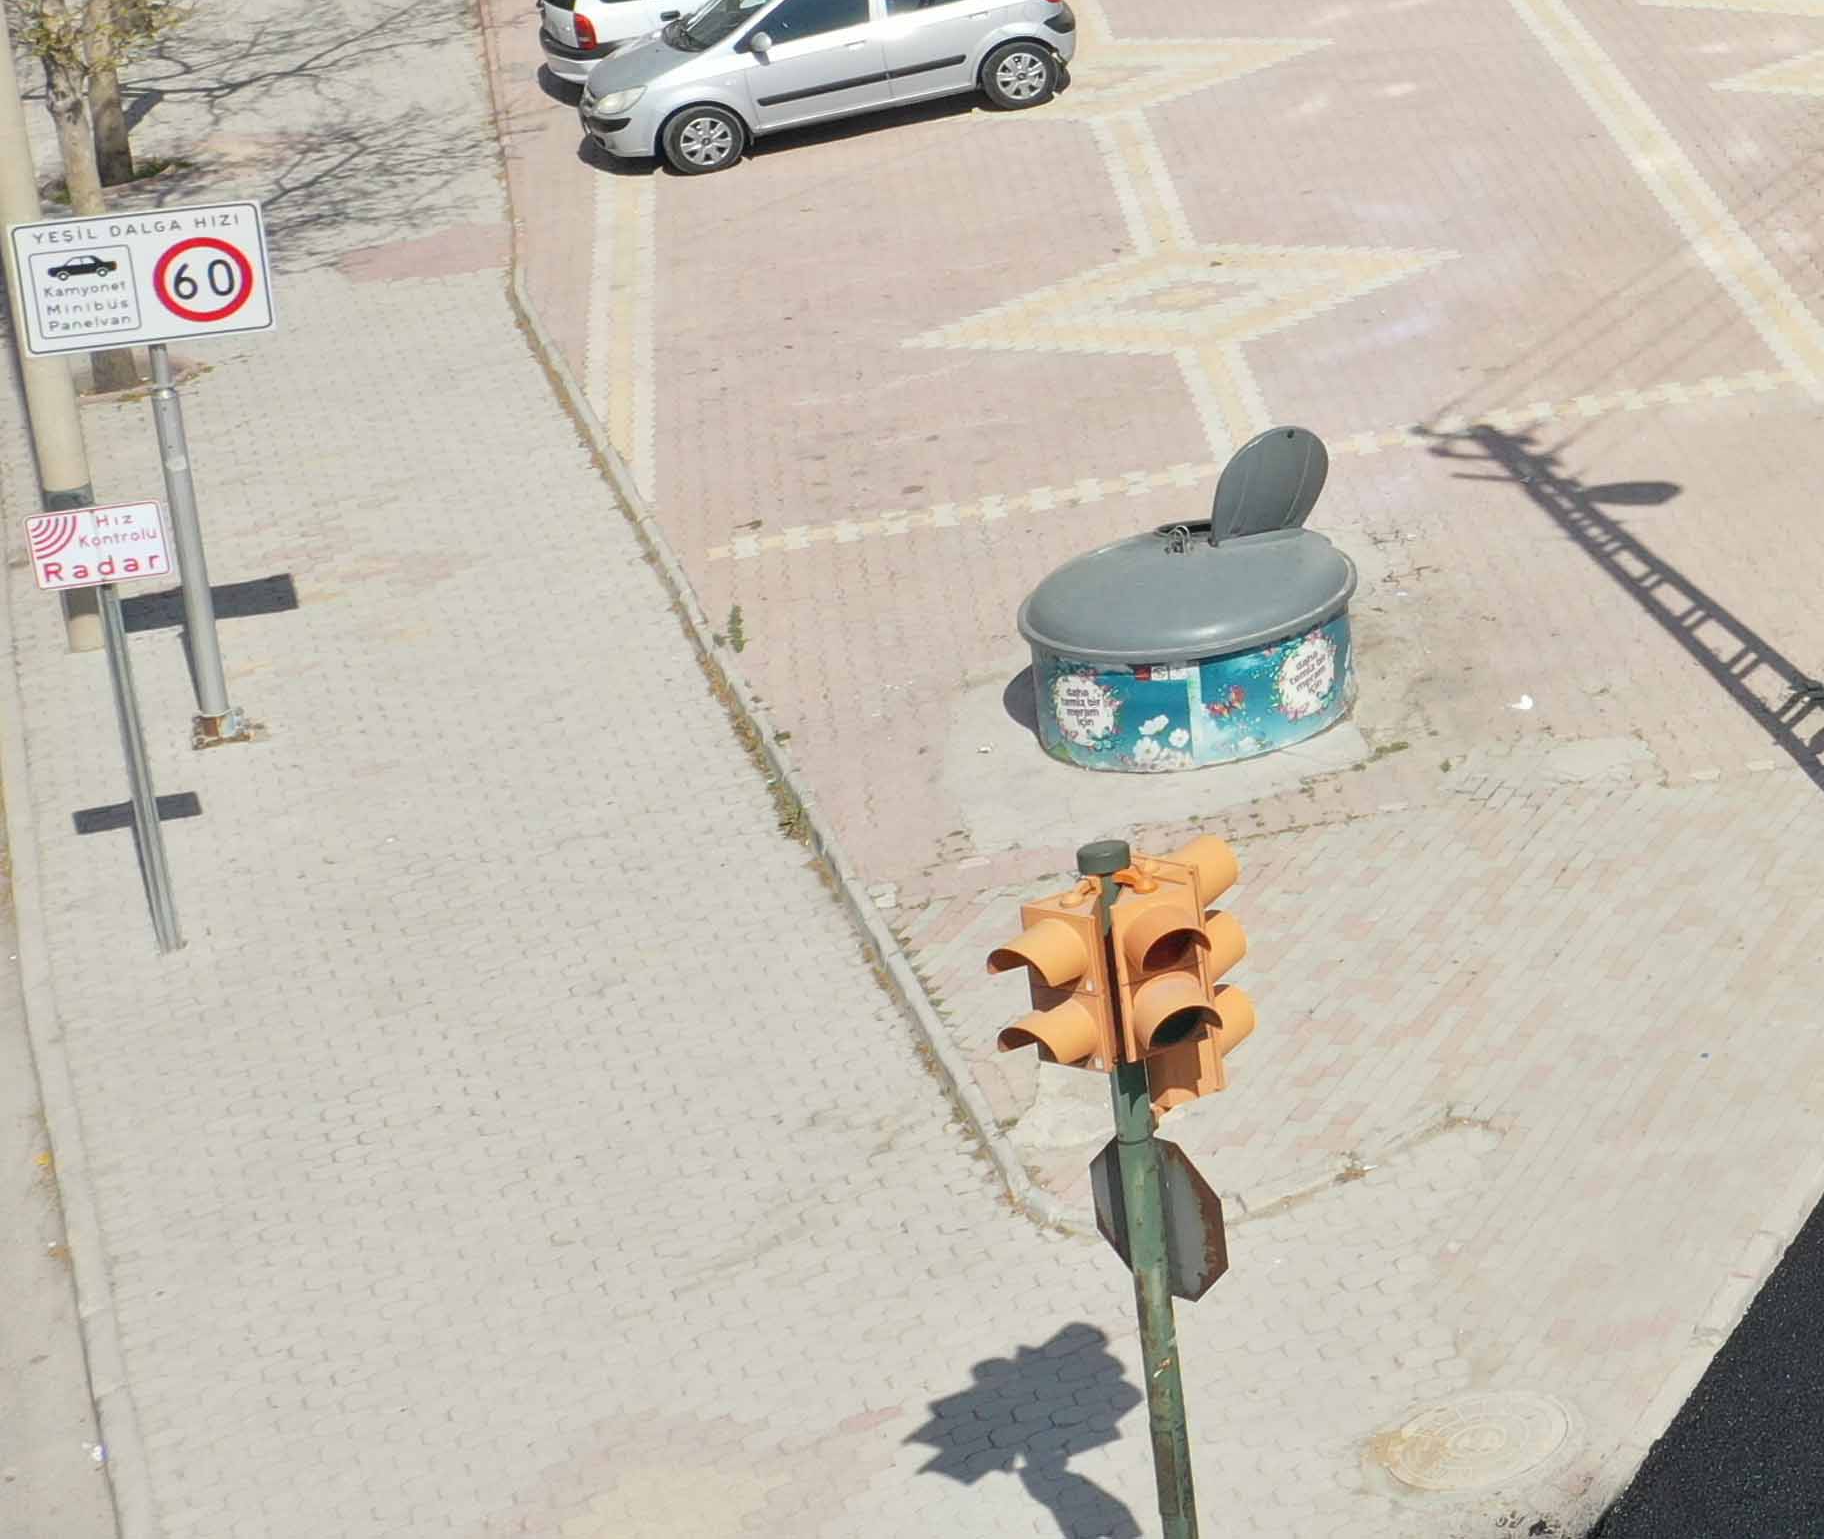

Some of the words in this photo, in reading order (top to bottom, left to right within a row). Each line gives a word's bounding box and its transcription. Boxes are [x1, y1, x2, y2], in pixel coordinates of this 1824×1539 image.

[32, 226, 98, 245] YEŞİL
[110, 218, 182, 238] DALGA
[194, 212, 239, 229] HIZI
[43, 280, 126, 298] Kamyonet
[172, 258, 236, 301] 60
[48, 315, 132, 332] Panelvan
[43, 554, 160, 582] Radar
